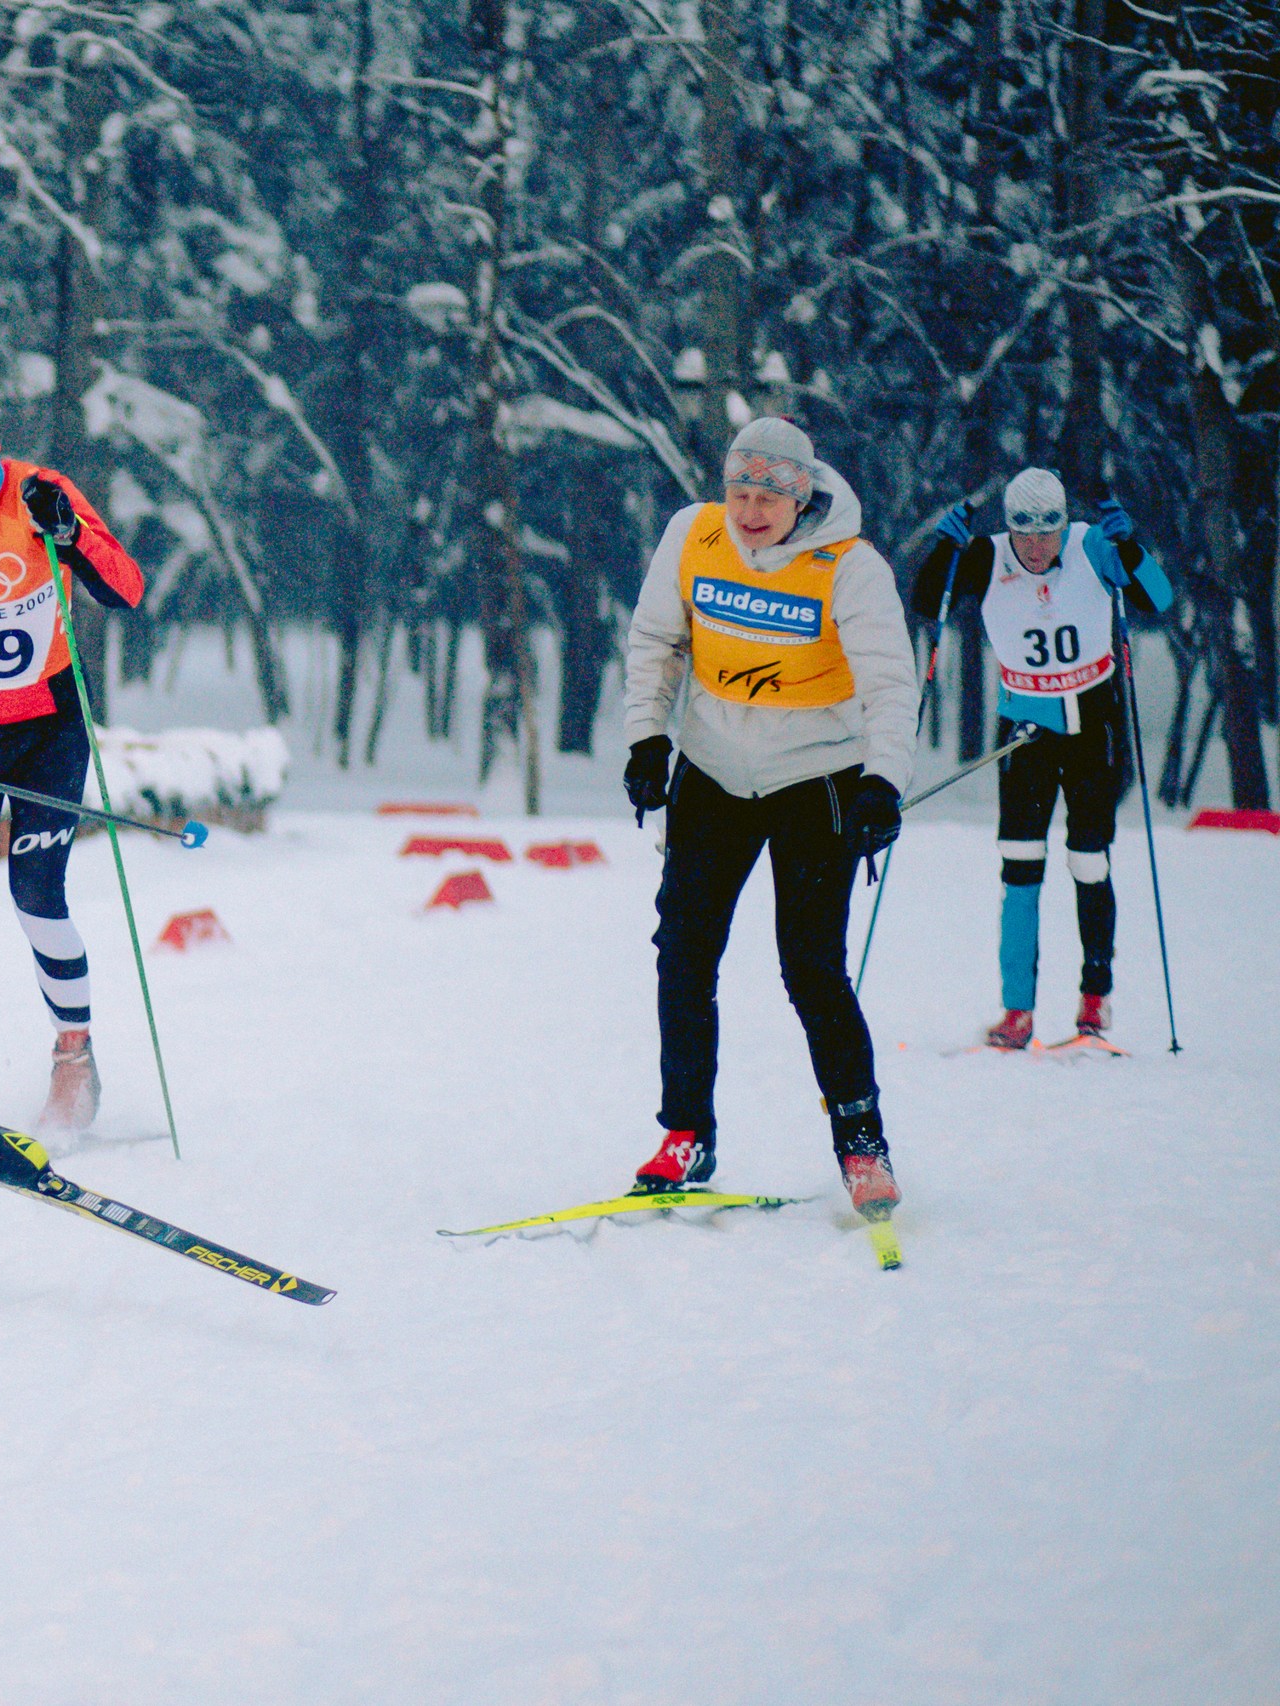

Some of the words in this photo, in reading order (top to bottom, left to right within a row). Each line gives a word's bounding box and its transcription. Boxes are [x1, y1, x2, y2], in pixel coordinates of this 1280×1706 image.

[14, 585, 54, 616] 2002
[695, 583, 816, 623] Buderus
[1023, 624, 1080, 668] 30
[184, 1245, 271, 1286] FISCHER
